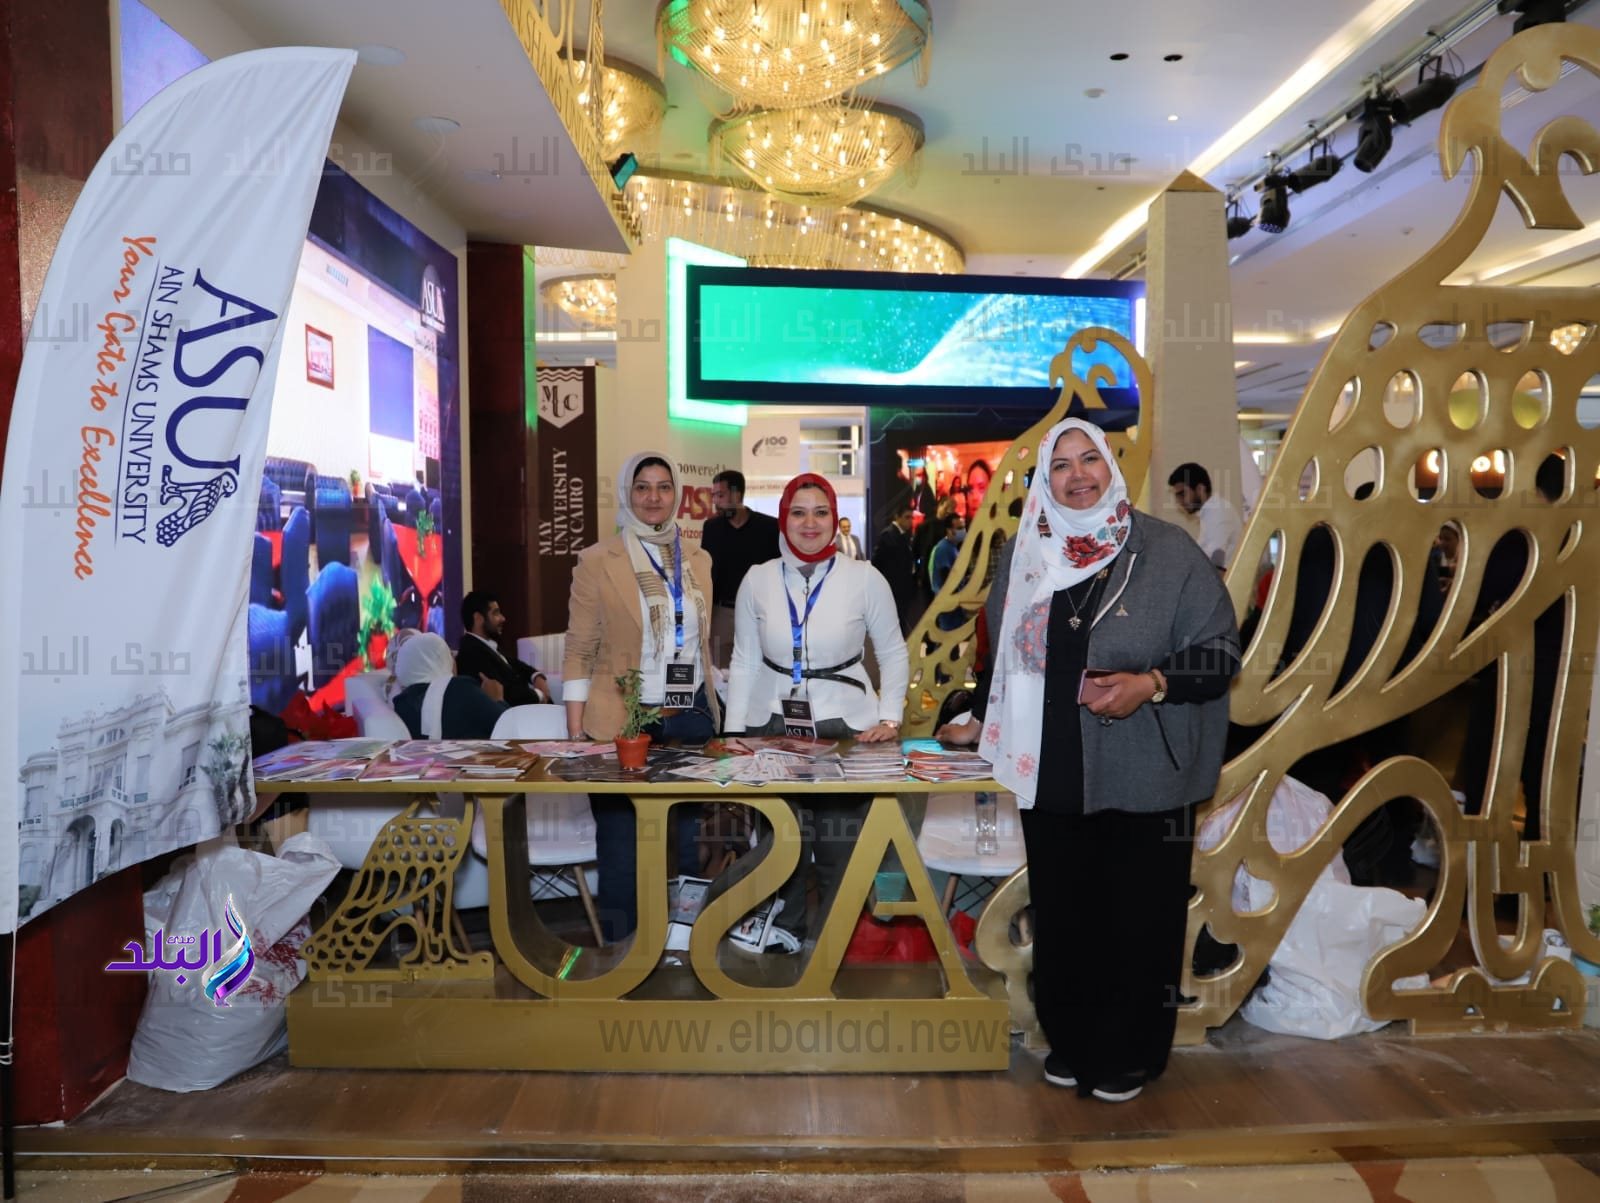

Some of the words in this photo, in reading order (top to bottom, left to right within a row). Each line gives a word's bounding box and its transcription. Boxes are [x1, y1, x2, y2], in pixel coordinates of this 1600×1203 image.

[113, 236, 157, 304] Your
[156, 265, 185, 304] AIN
[97, 311, 136, 376] Gate
[136, 310, 173, 392] SHAMS
[165, 268, 278, 476] ASU
[90, 377, 120, 411] to
[74, 426, 115, 580] Excellence
[123, 402, 156, 544] UNIVERSITY
[552, 448, 568, 556] UNIVERSITY
[569, 477, 584, 533] CAIRO
[538, 520, 552, 556] MAY
